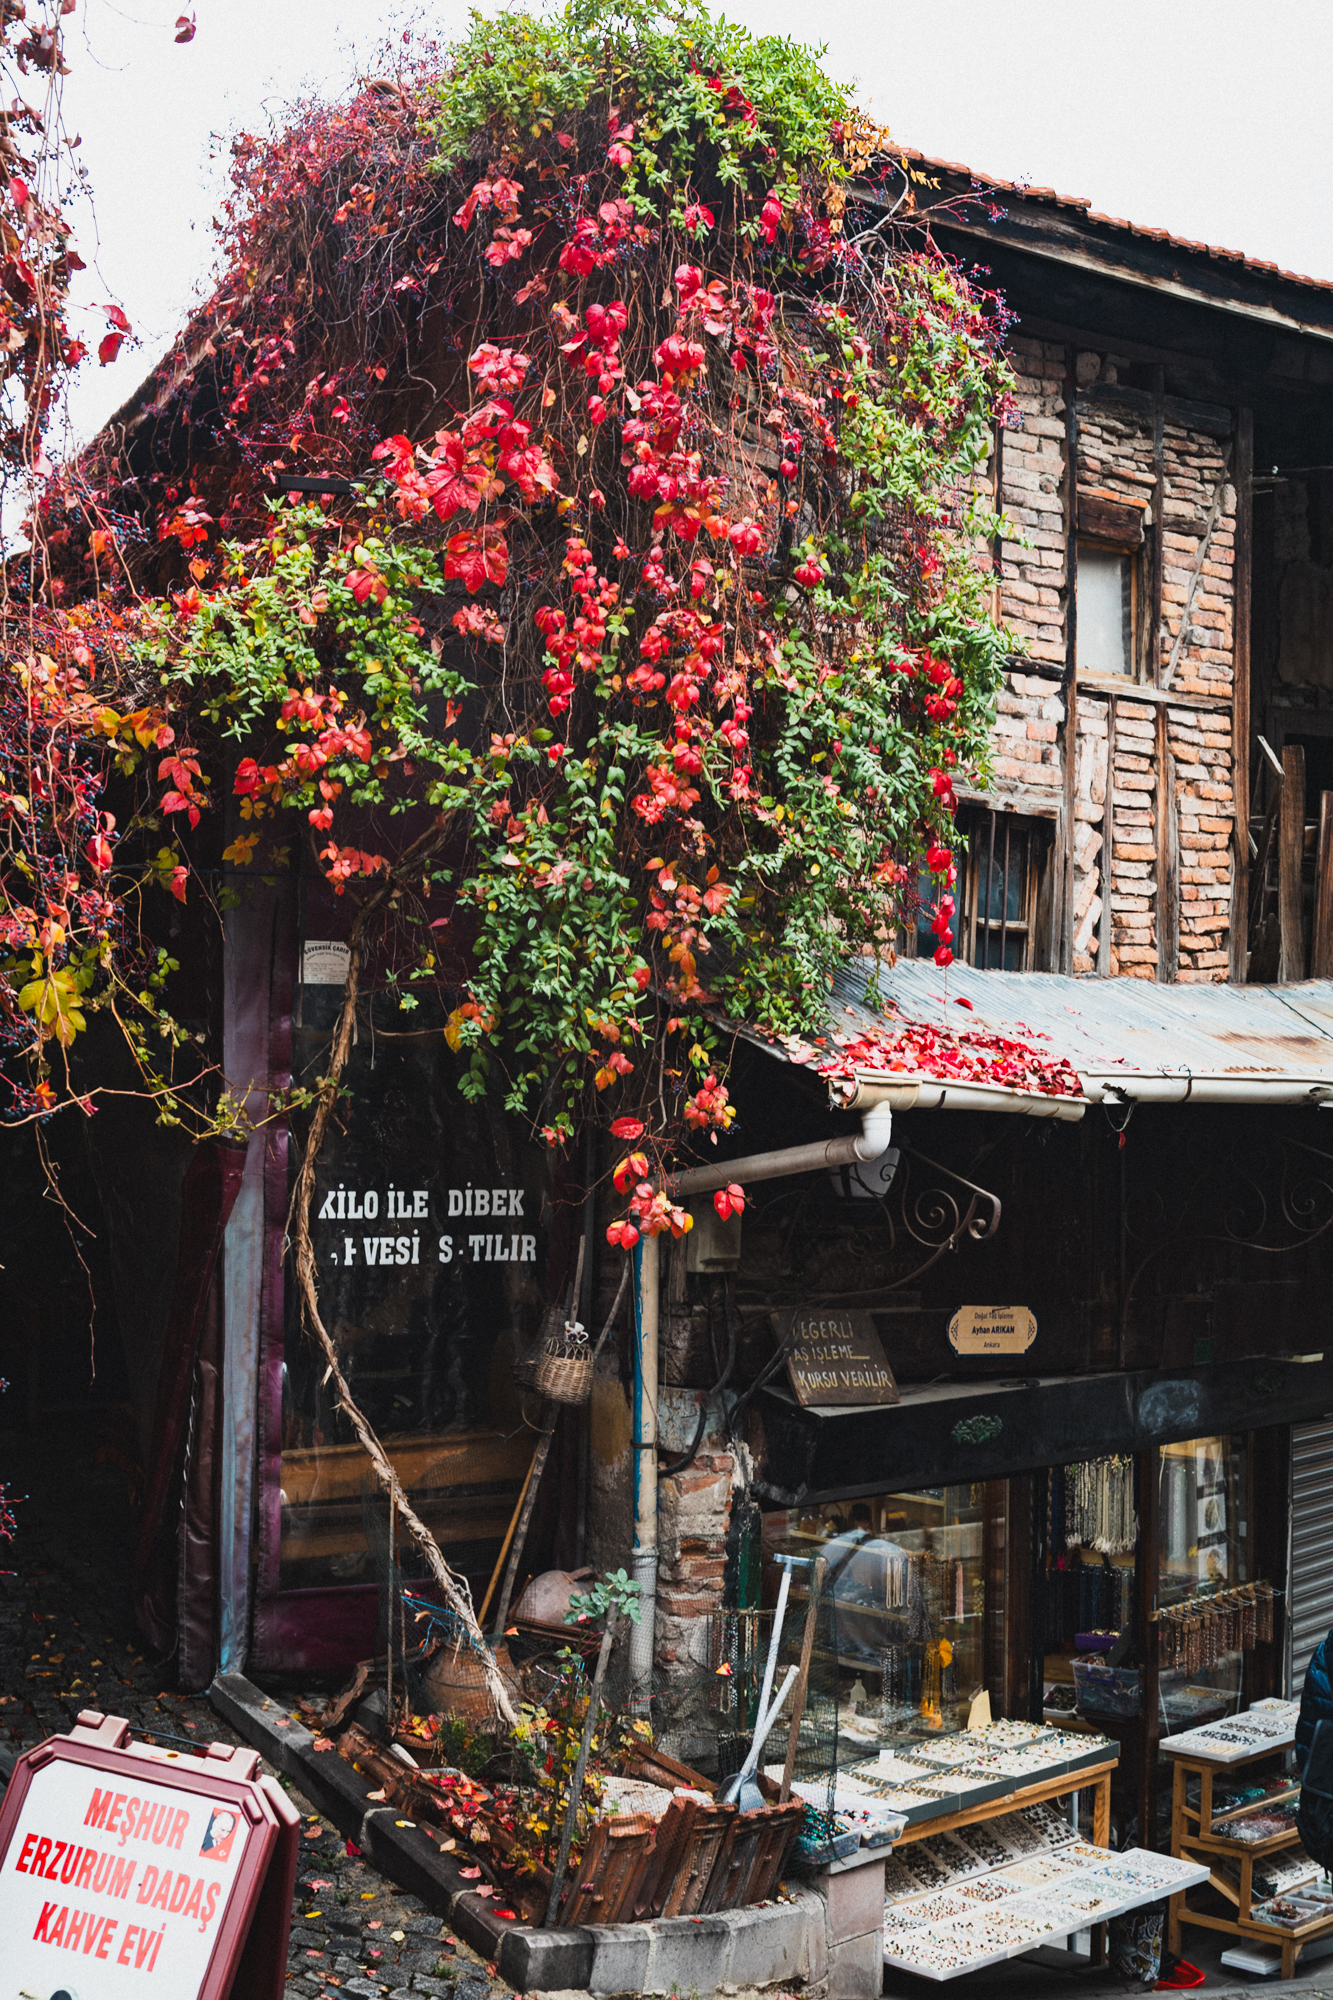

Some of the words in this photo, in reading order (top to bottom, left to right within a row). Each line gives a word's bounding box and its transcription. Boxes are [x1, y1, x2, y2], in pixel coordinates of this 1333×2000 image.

[387, 1183, 429, 1218] İLE
[448, 1181, 525, 1217] DİBEK
[439, 1234, 537, 1264] STILIR
[793, 1313, 854, 1340] EĞERLİ
[972, 1326, 990, 1336] Ayhan
[991, 1326, 1015, 1334] ARIKAN
[784, 1346, 810, 1366] AŞ
[797, 1370, 838, 1391] KURSU
[840, 1364, 893, 1389] VERİLİR
[83, 1788, 190, 1850] MEŞHUR
[15, 1833, 138, 1900] ERZURUM
[136, 1864, 222, 1933] DADAŞ
[33, 1901, 118, 1960] KAHVE
[117, 1923, 167, 1973] EVİ
